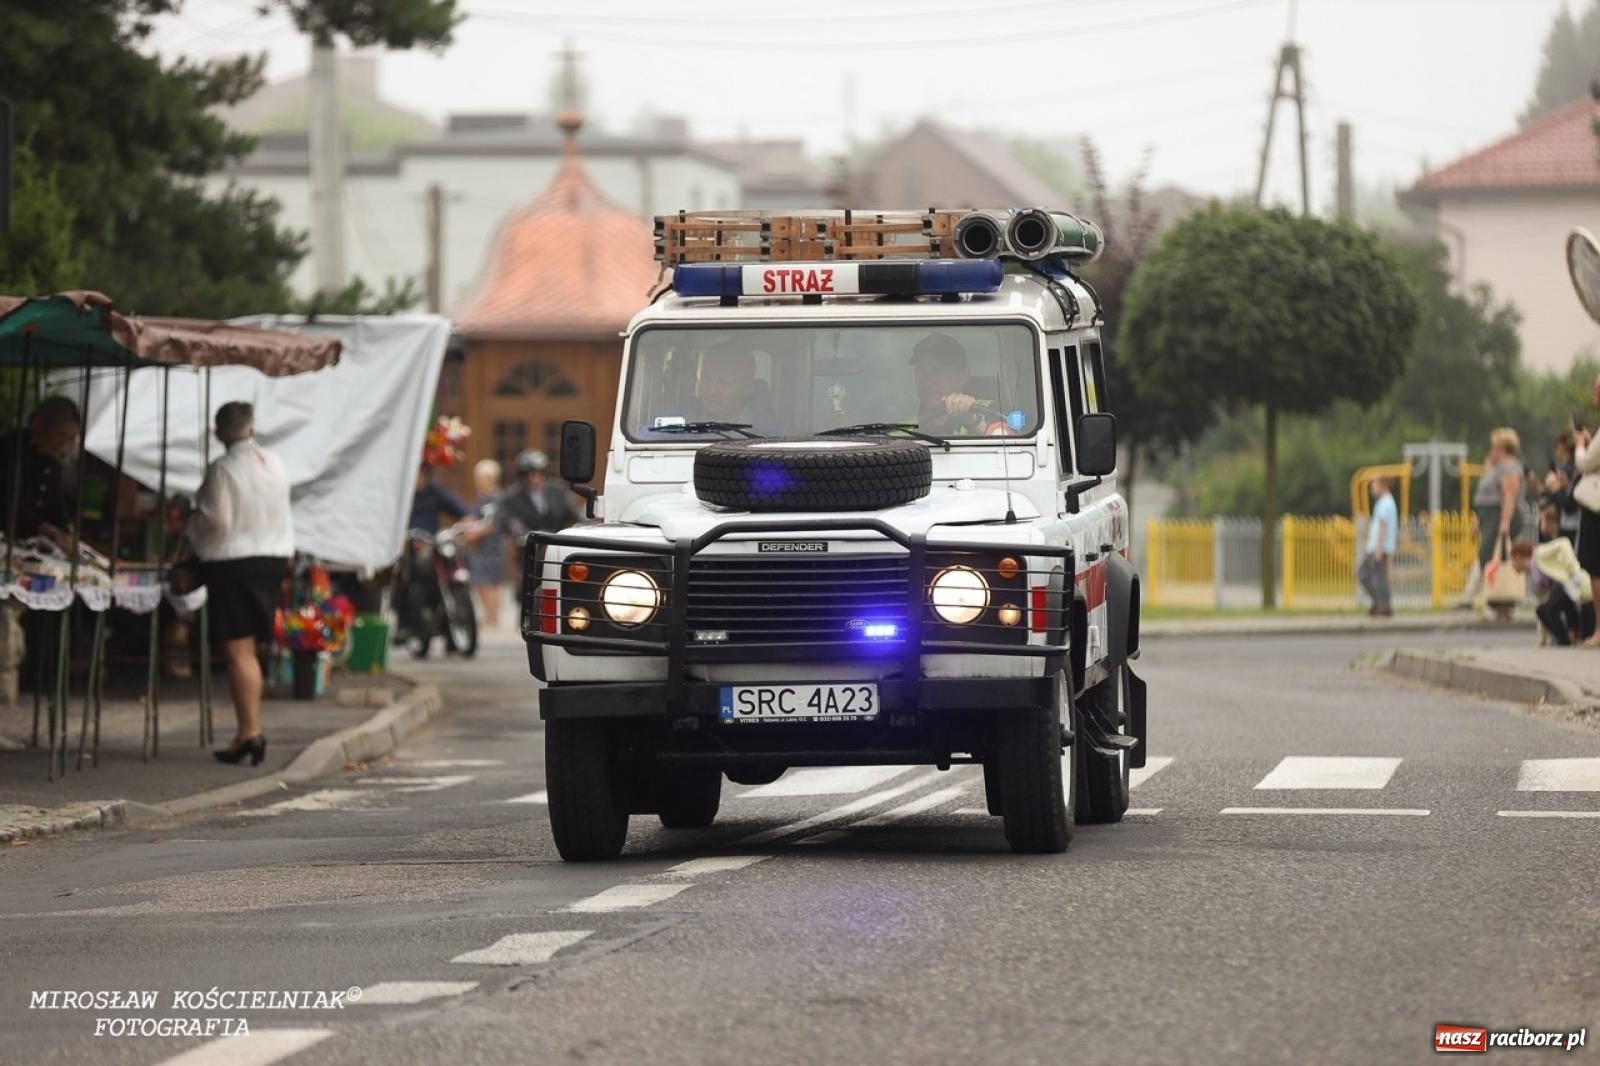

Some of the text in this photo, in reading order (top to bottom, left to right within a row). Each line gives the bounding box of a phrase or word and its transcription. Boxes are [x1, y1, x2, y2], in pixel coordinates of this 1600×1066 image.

[761, 543, 824, 551] DEFENDER
[737, 686, 873, 716] SRC 4A23
